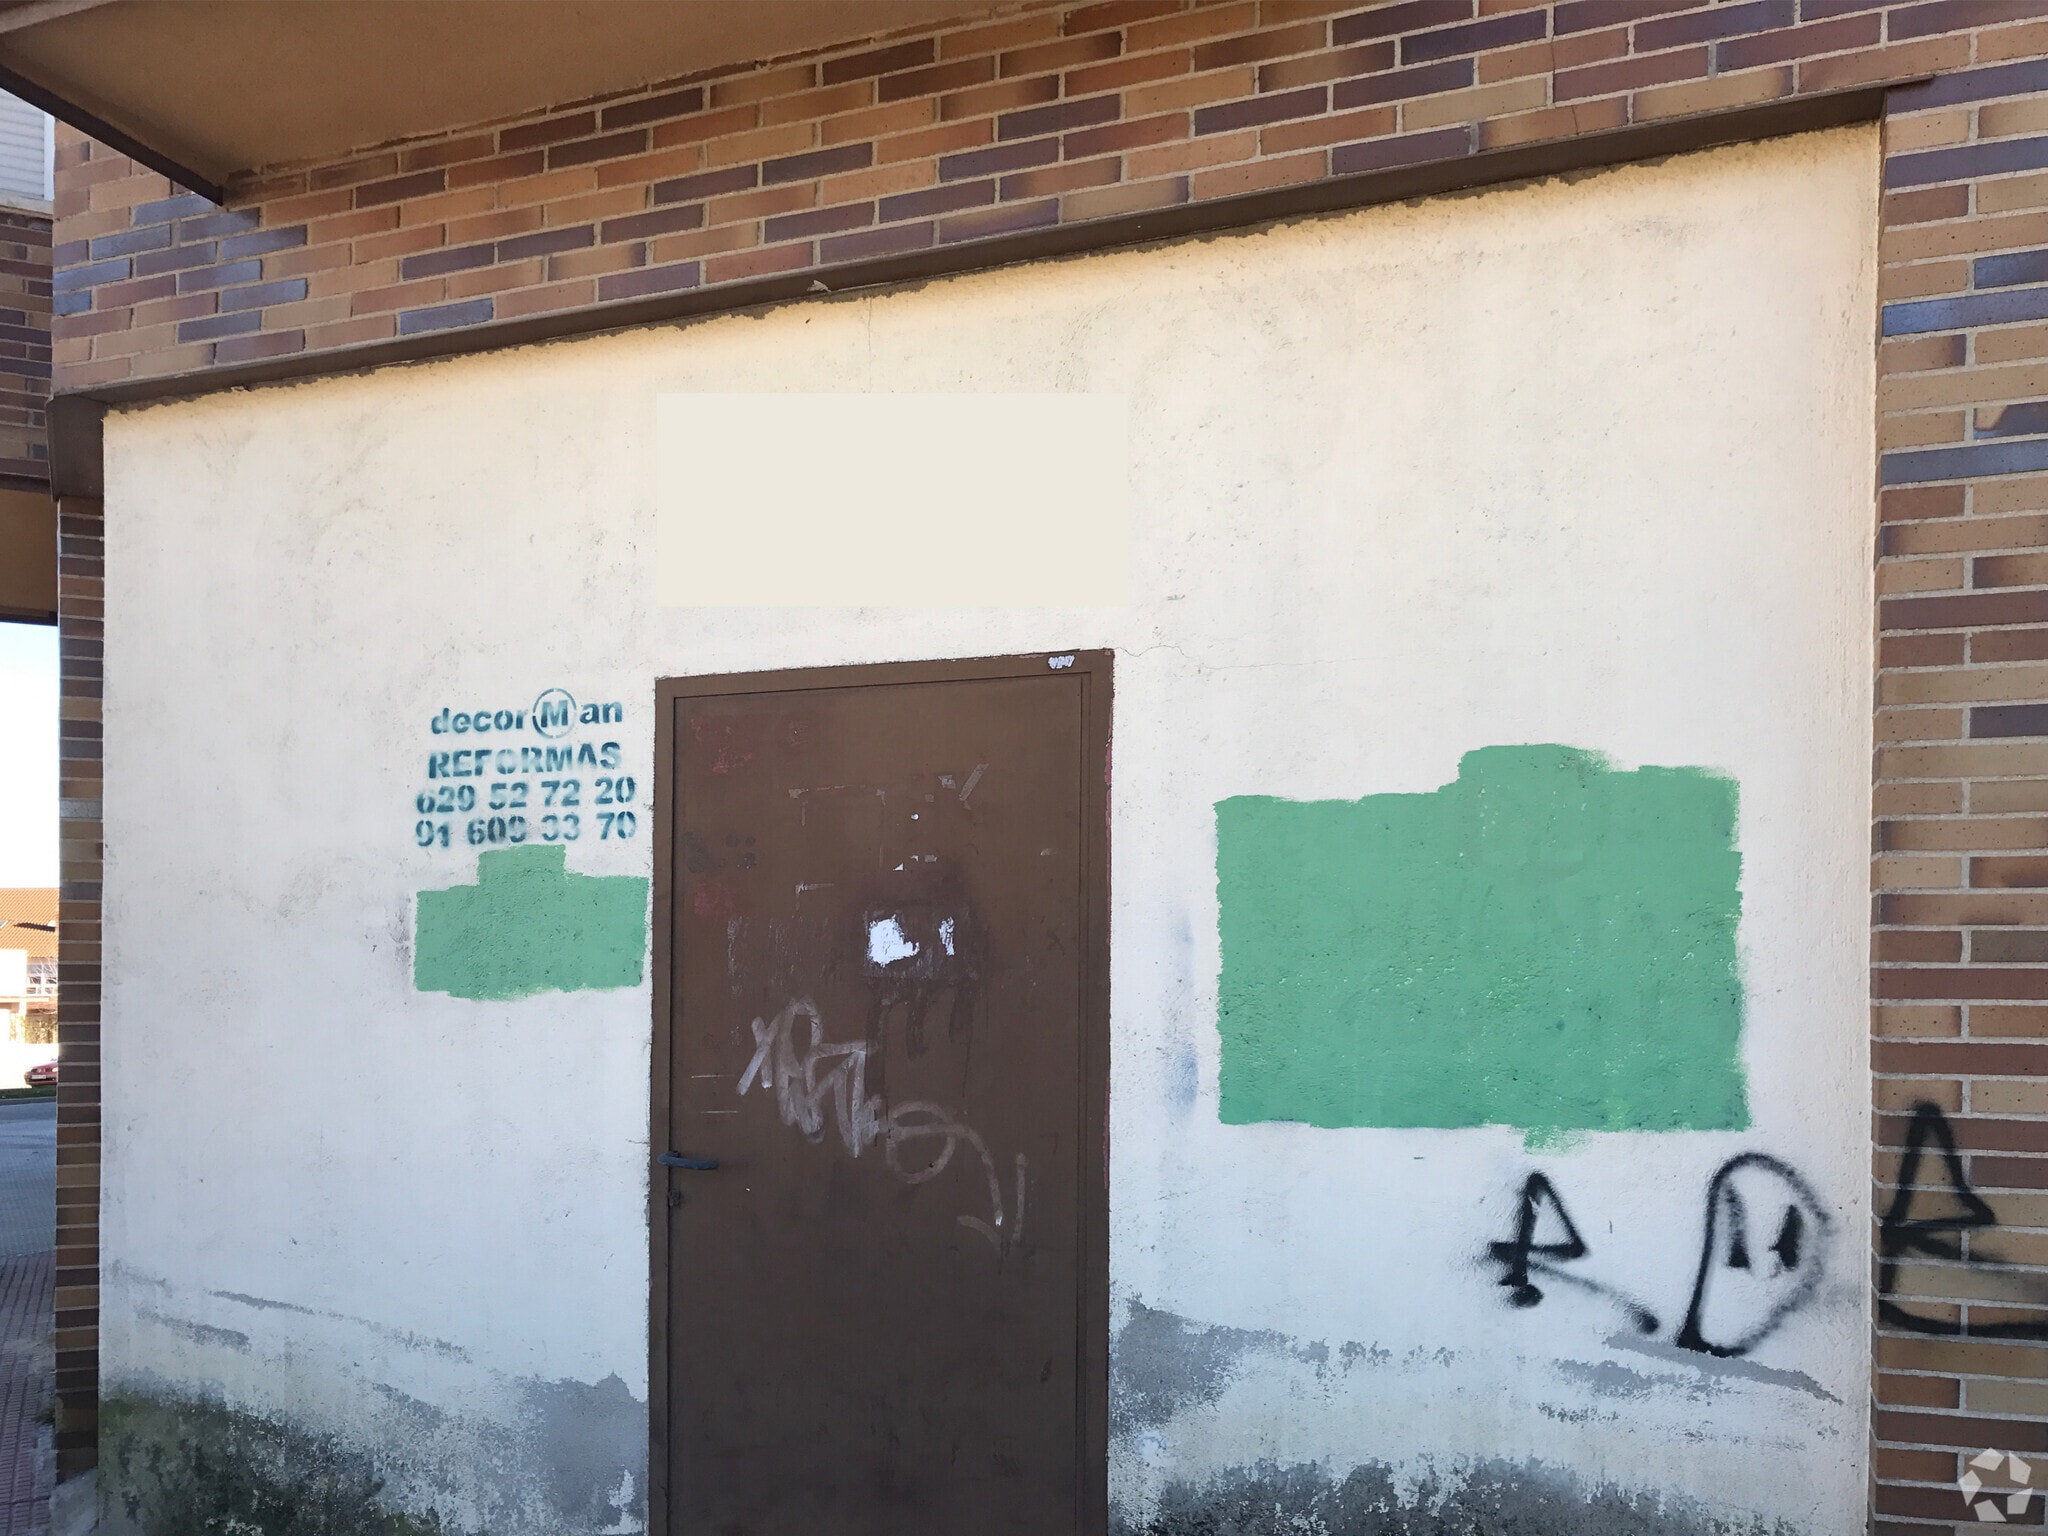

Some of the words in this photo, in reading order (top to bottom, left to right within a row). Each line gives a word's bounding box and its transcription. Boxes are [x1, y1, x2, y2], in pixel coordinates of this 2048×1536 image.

[428, 741, 621, 778] REFORMAS
[416, 785, 475, 814] 629
[489, 781, 528, 810] 52
[541, 778, 580, 807] 72
[594, 776, 635, 804] 20
[416, 819, 449, 847] 91
[541, 813, 580, 841] 33
[596, 811, 636, 840] 70
